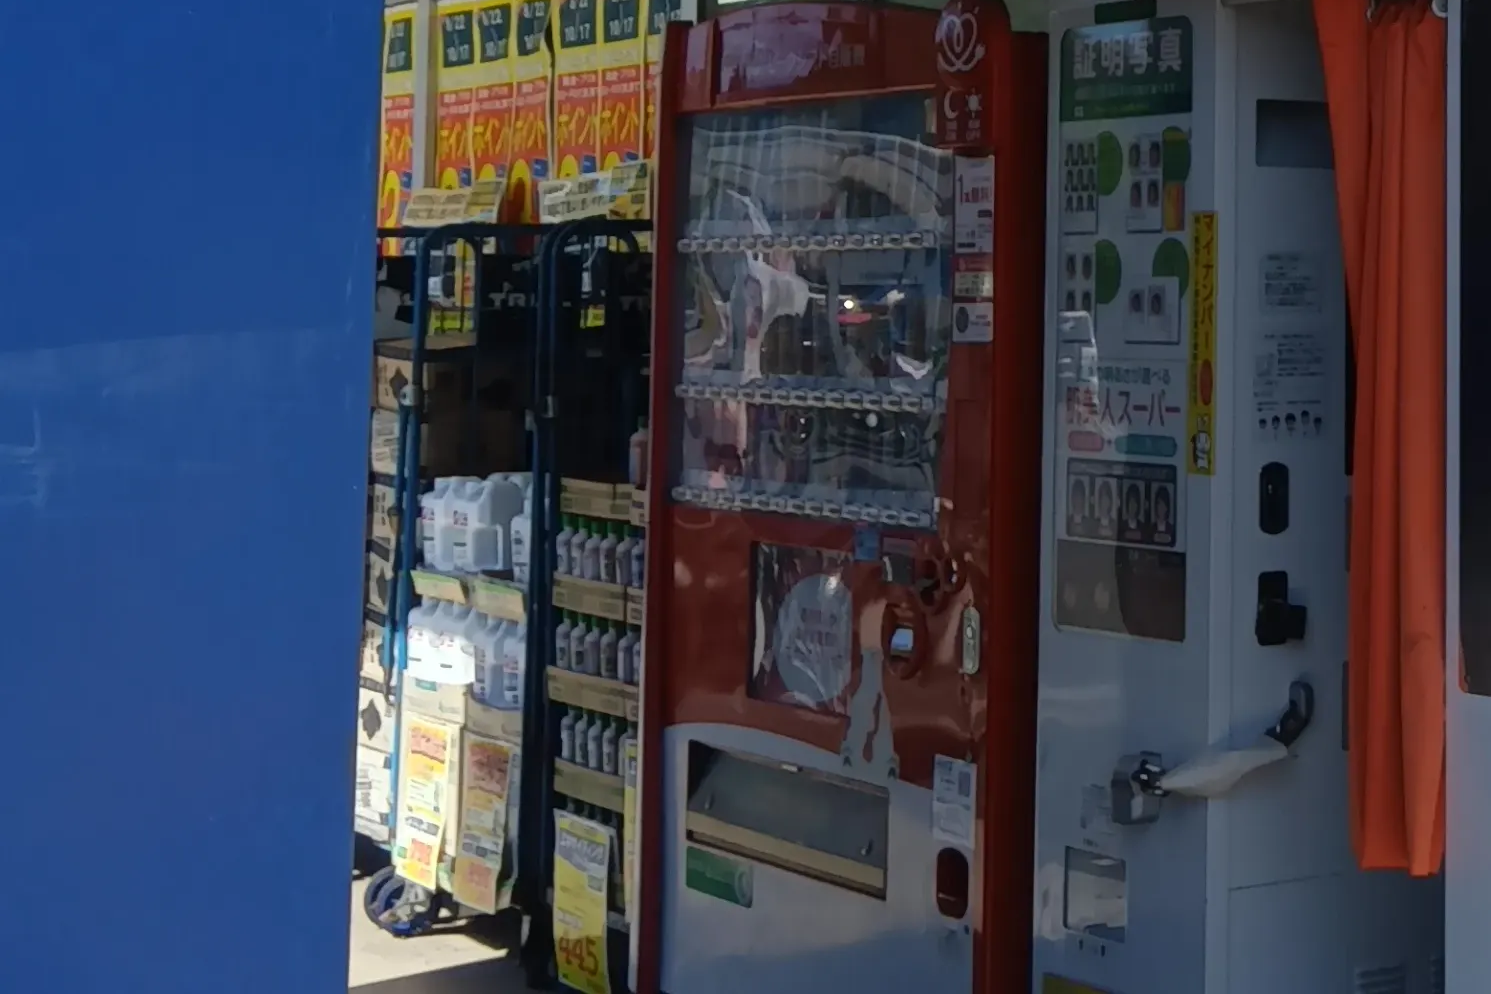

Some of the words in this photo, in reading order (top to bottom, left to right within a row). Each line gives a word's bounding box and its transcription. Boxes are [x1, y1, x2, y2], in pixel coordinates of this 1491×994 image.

[1073, 25, 1183, 80] 証明写真
[1200, 214, 1215, 350] マイナンバー
